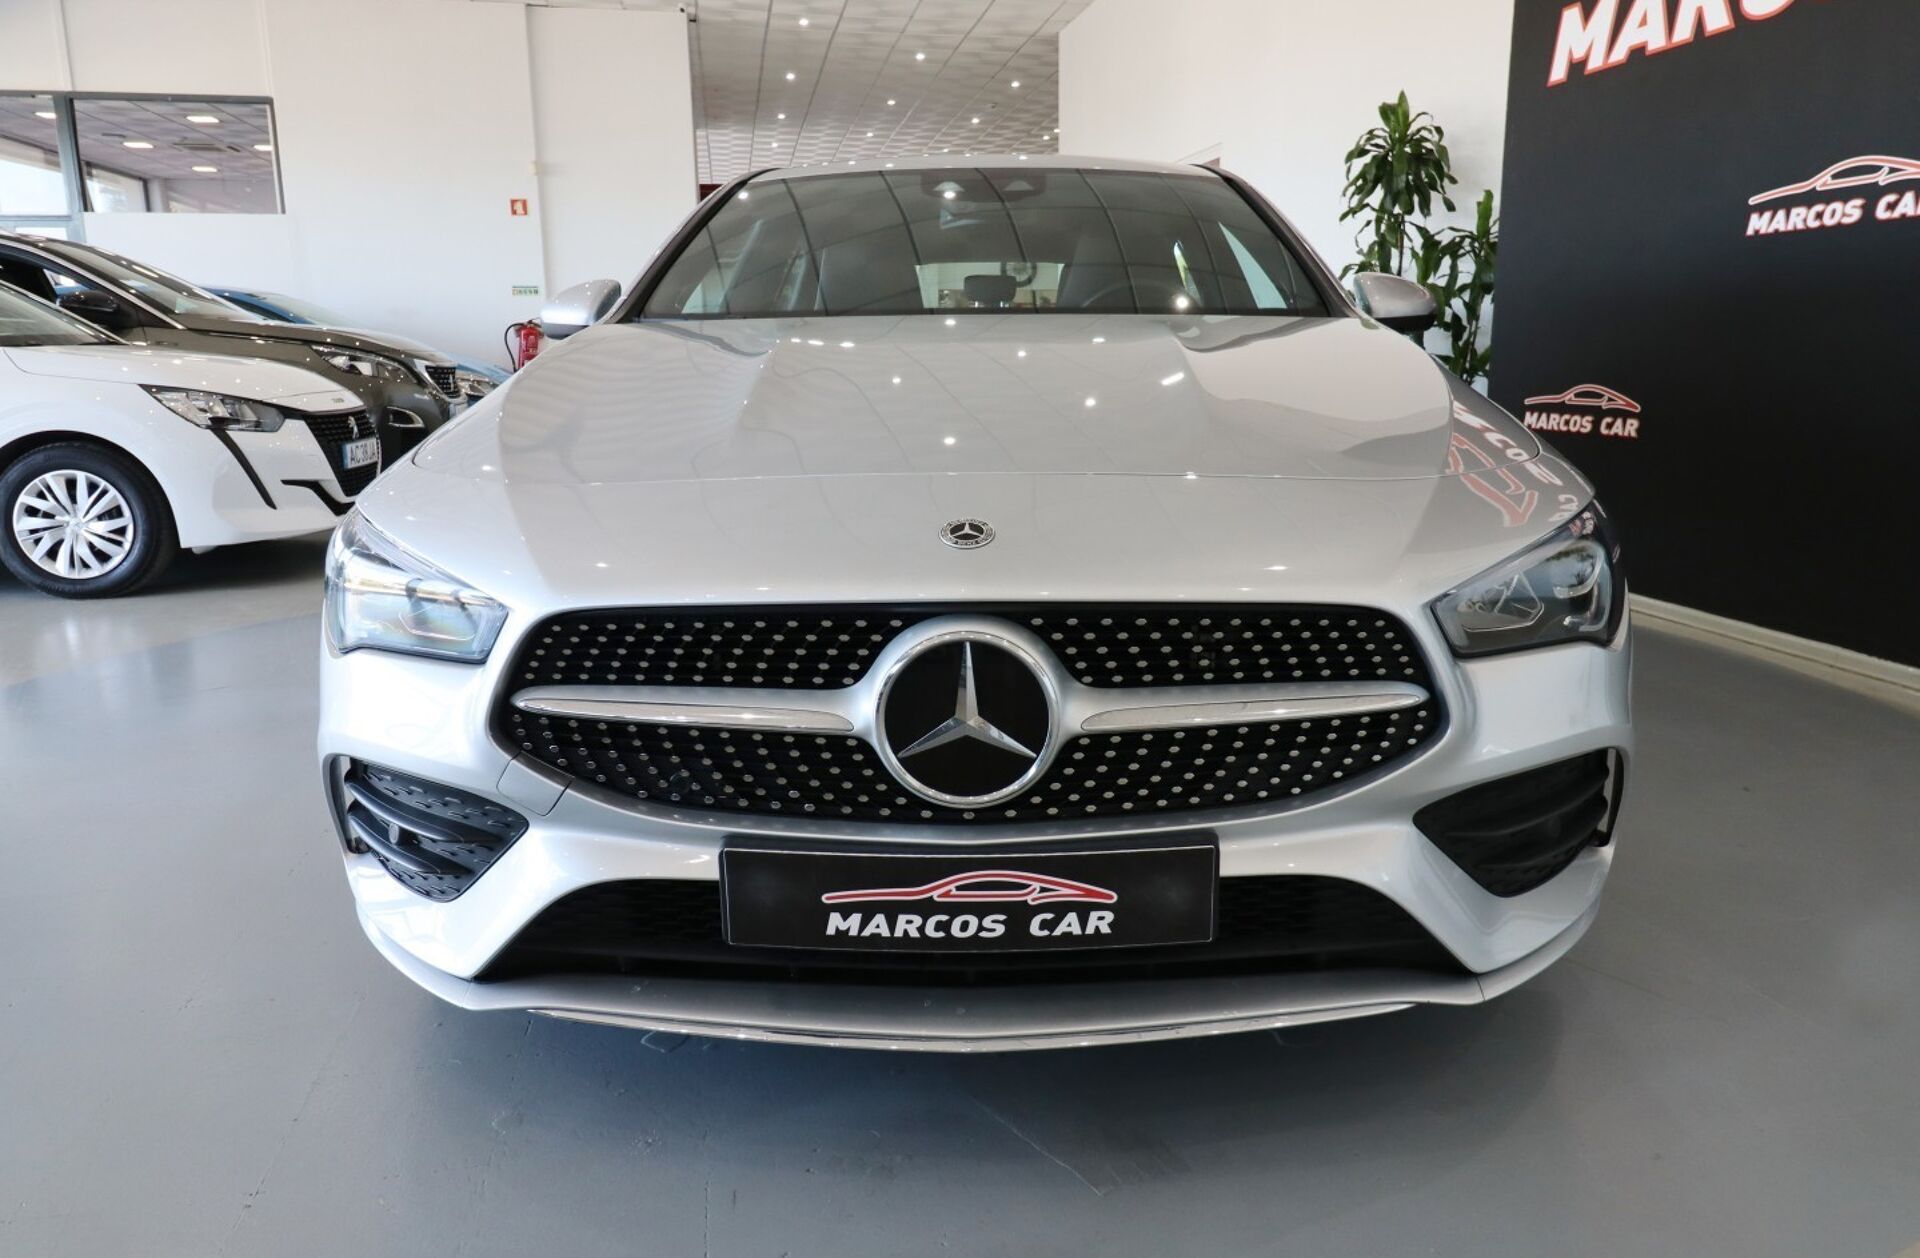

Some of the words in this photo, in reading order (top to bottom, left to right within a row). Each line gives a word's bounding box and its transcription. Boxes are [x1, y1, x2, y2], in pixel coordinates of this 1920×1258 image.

[1745, 198, 1867, 237] MARCOS
[1874, 190, 1920, 221] CA
[1523, 411, 1595, 433] MARCOS
[1600, 416, 1640, 438] CAR
[825, 911, 1007, 938] MARCOS
[1029, 910, 1115, 937] CAR
